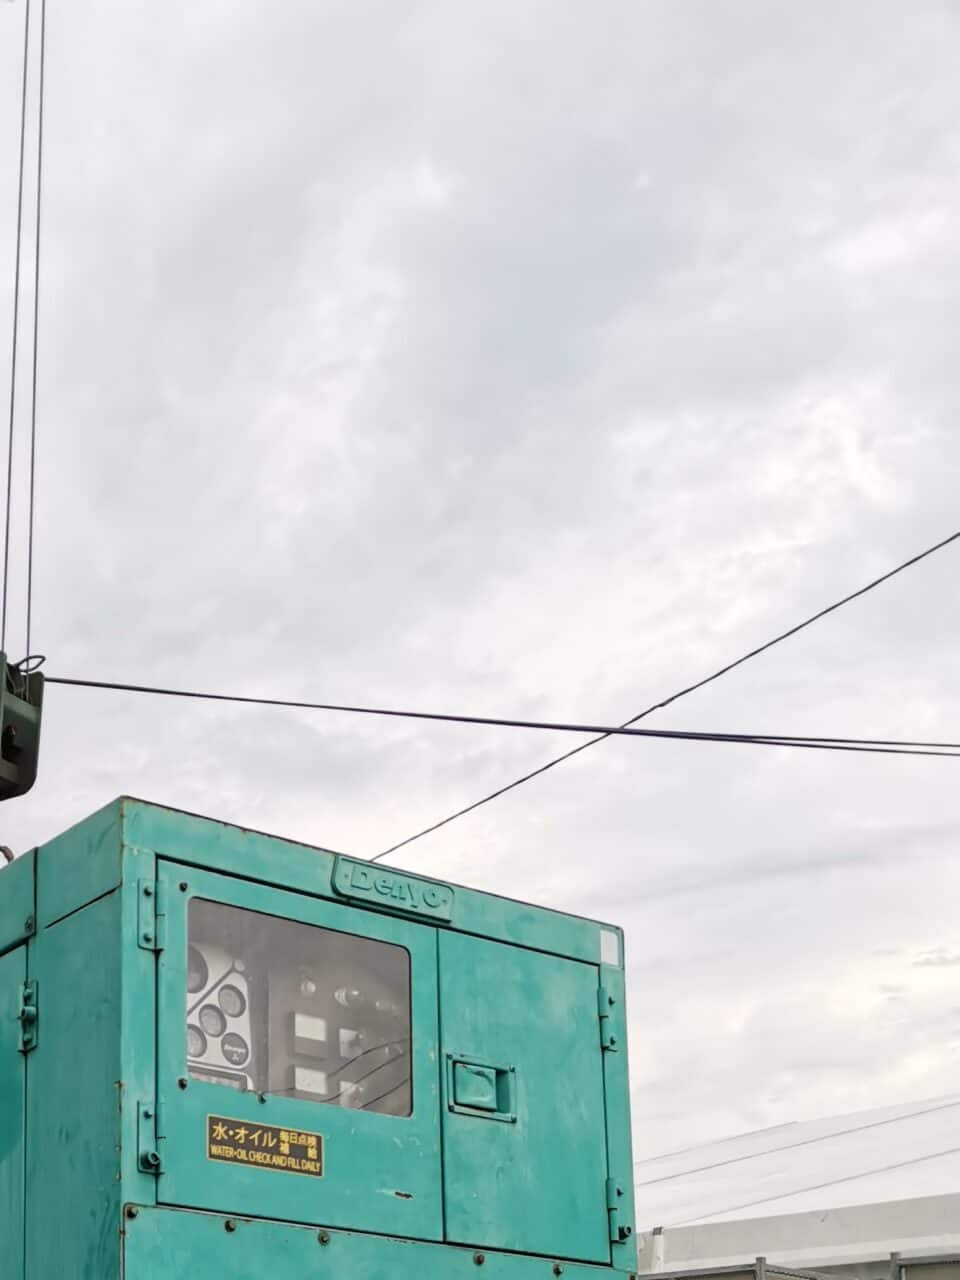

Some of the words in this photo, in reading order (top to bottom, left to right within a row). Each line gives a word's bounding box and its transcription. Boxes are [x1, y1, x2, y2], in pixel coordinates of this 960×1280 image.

[349, 864, 442, 909] Denyo
[249, 1150, 272, 1164] CHECK
[301, 1160, 320, 1172] DAILY
